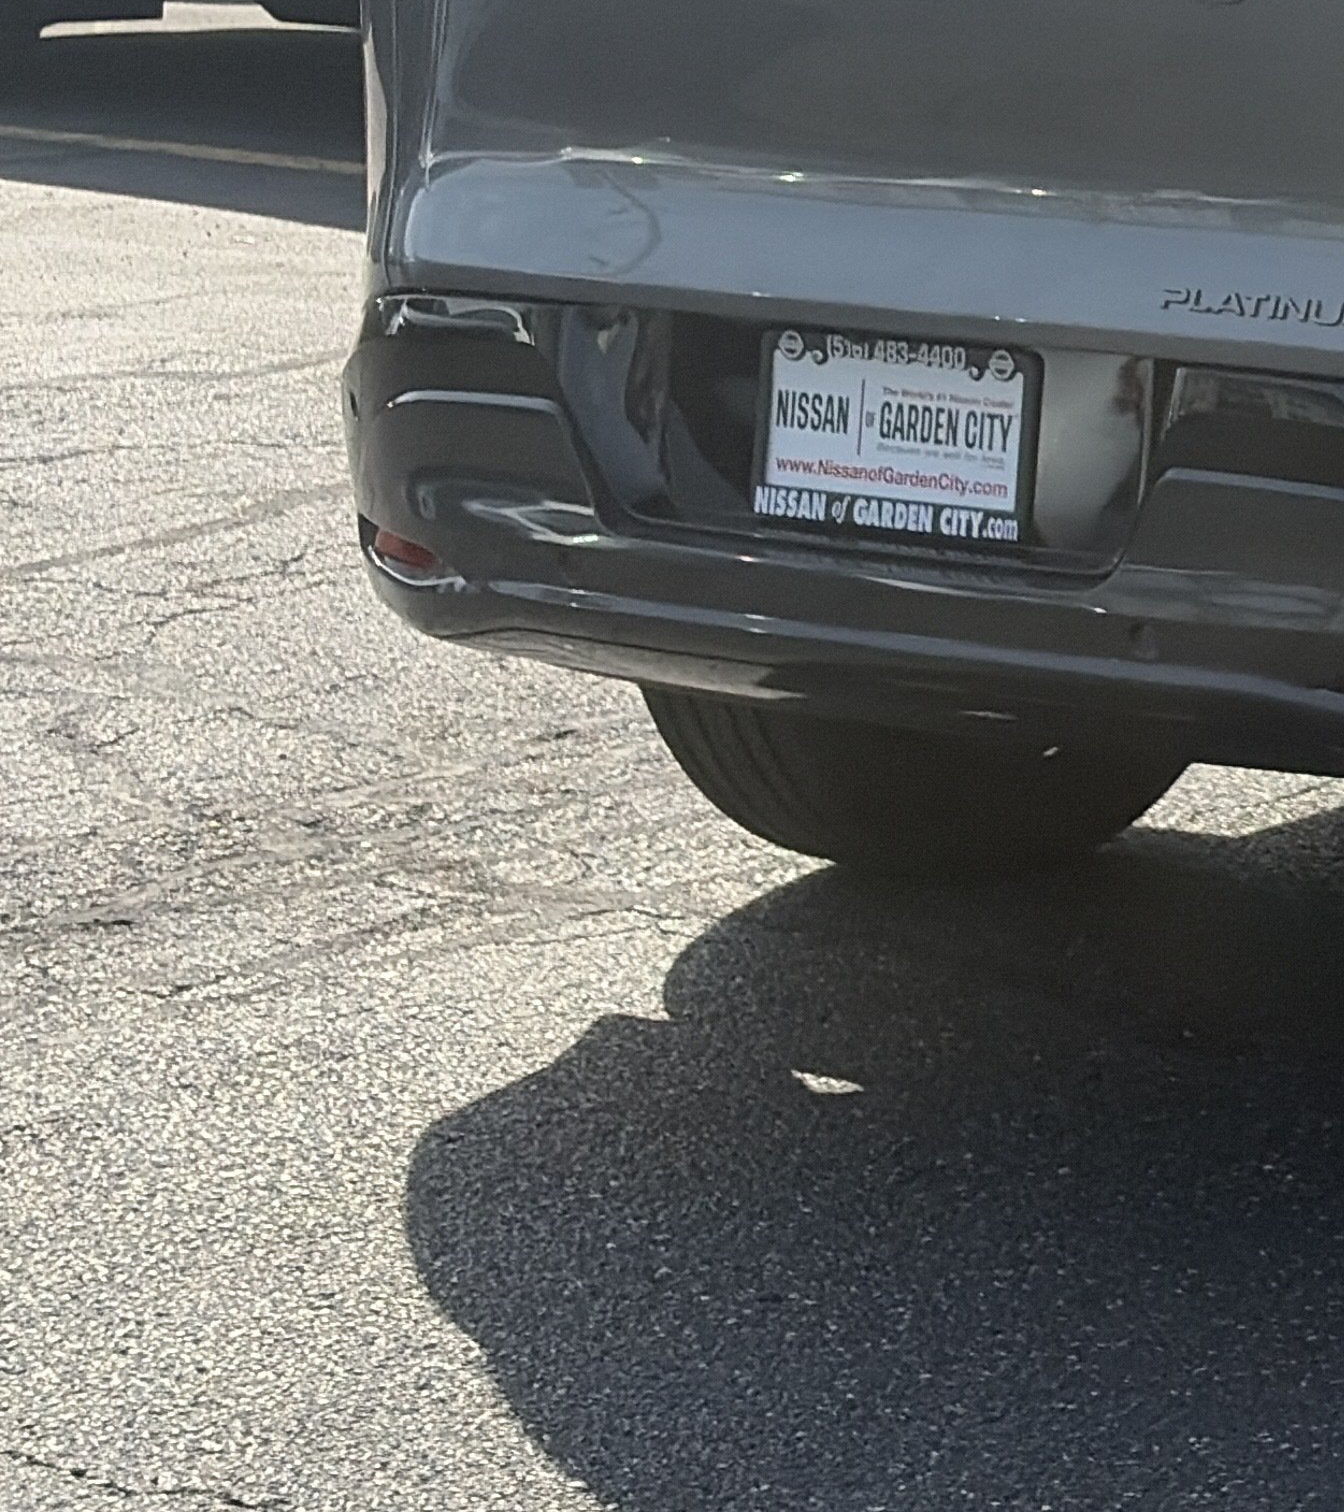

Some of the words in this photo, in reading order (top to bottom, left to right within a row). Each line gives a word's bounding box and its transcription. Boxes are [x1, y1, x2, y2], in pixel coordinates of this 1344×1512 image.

[872, 340, 967, 370] 483-4400
[776, 389, 850, 434] NISSAN
[879, 400, 960, 448] GARDEN
[964, 409, 1013, 453] CITY
[776, 456, 1009, 498] www.NissanofGardenCity.com
[754, 485, 826, 522] NISSAN
[831, 496, 851, 524] of
[853, 498, 934, 533] GARDEN
